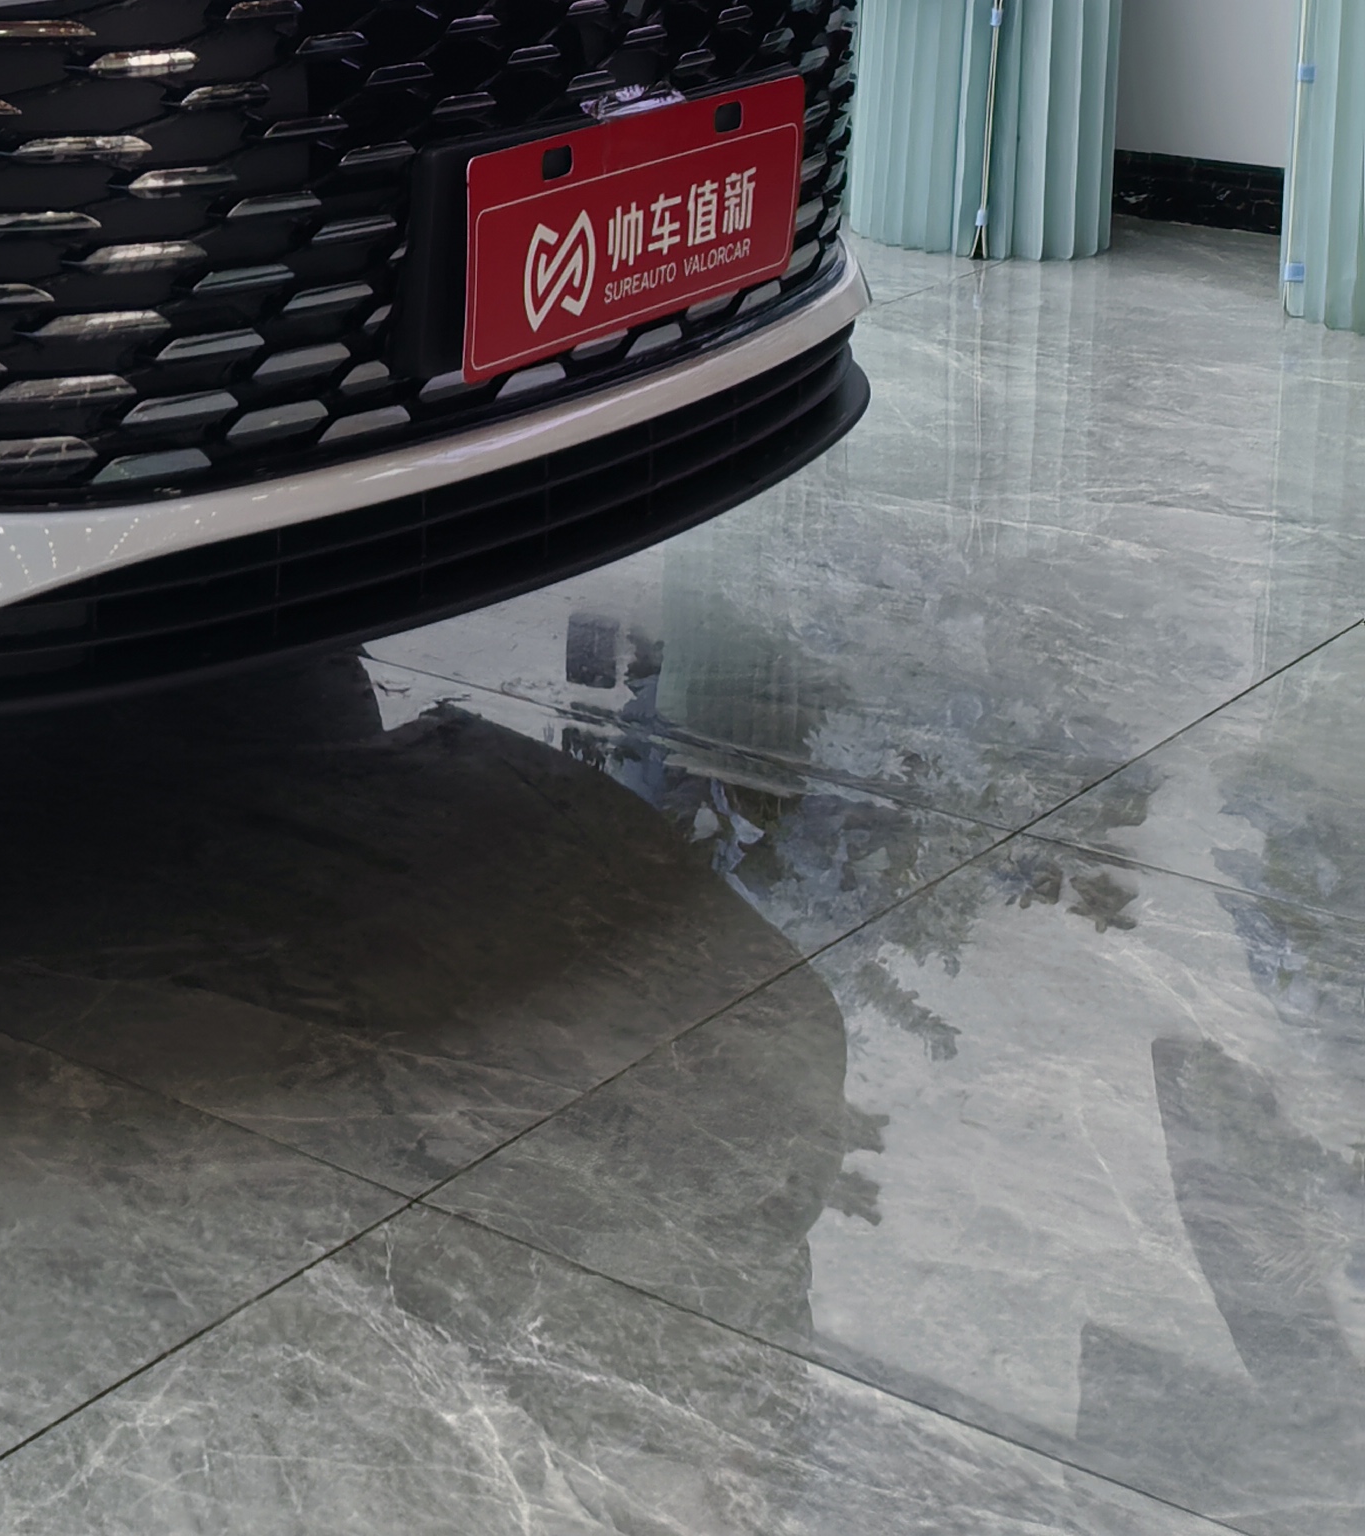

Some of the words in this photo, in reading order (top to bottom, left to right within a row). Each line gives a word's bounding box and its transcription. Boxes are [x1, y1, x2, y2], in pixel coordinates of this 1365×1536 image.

[606, 166, 758, 273] 帅车值新
[603, 262, 677, 304] SUREAUTO
[683, 238, 751, 277] VALORCAR
